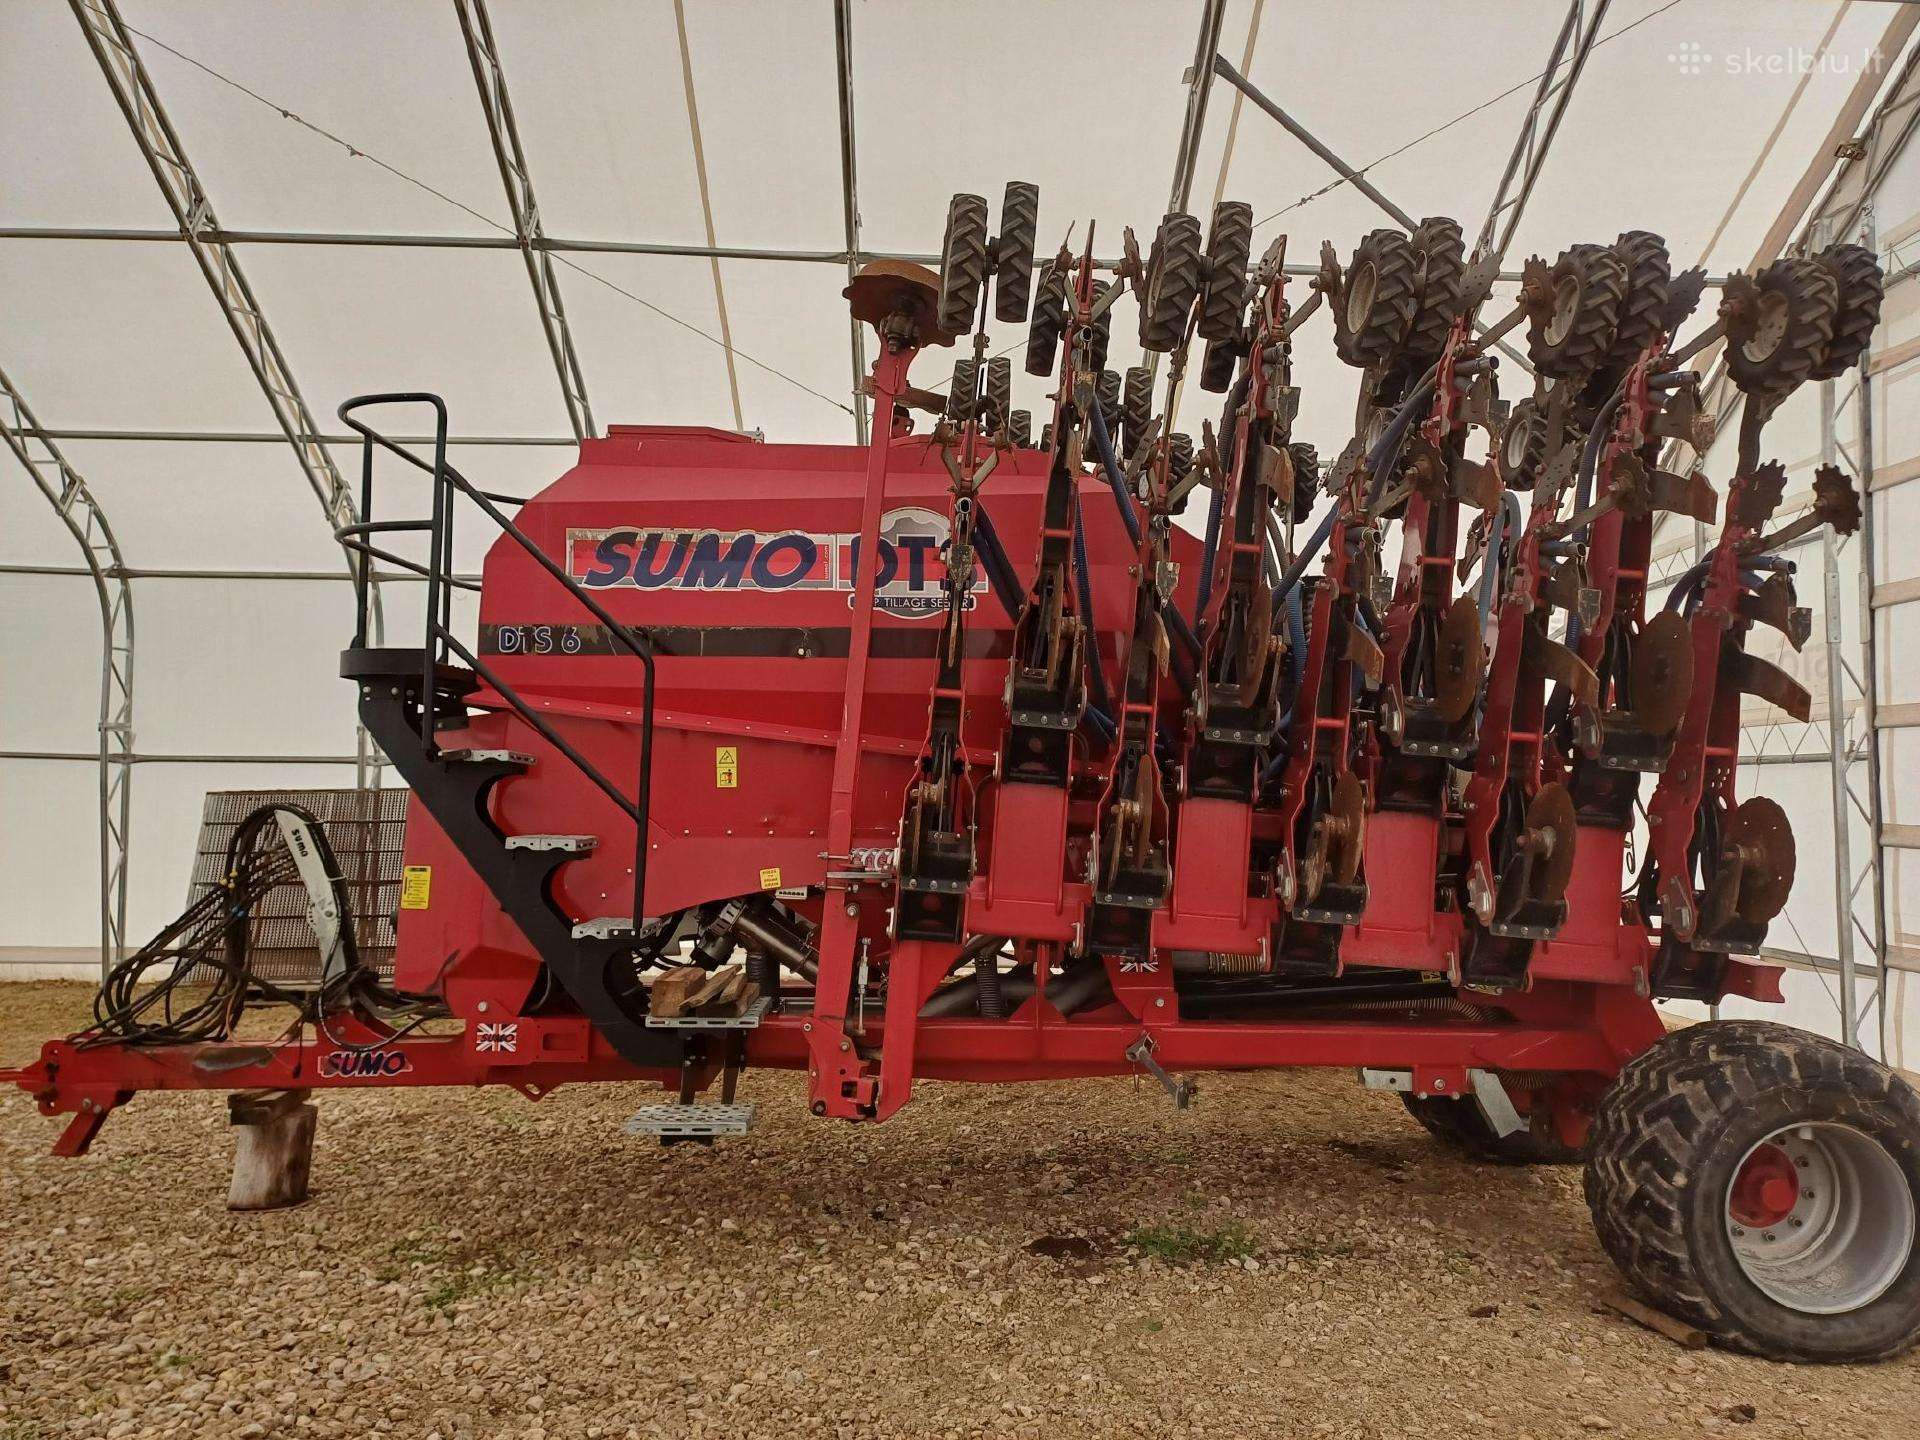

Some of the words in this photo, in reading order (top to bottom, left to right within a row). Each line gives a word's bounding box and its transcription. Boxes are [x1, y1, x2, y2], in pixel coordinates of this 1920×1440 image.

[582, 530, 819, 590] SUMO
[883, 597, 927, 608] TILLAGE
[561, 626, 581, 654] 6
[480, 1033, 515, 1043] SUMO
[322, 1050, 407, 1077] SUMO
